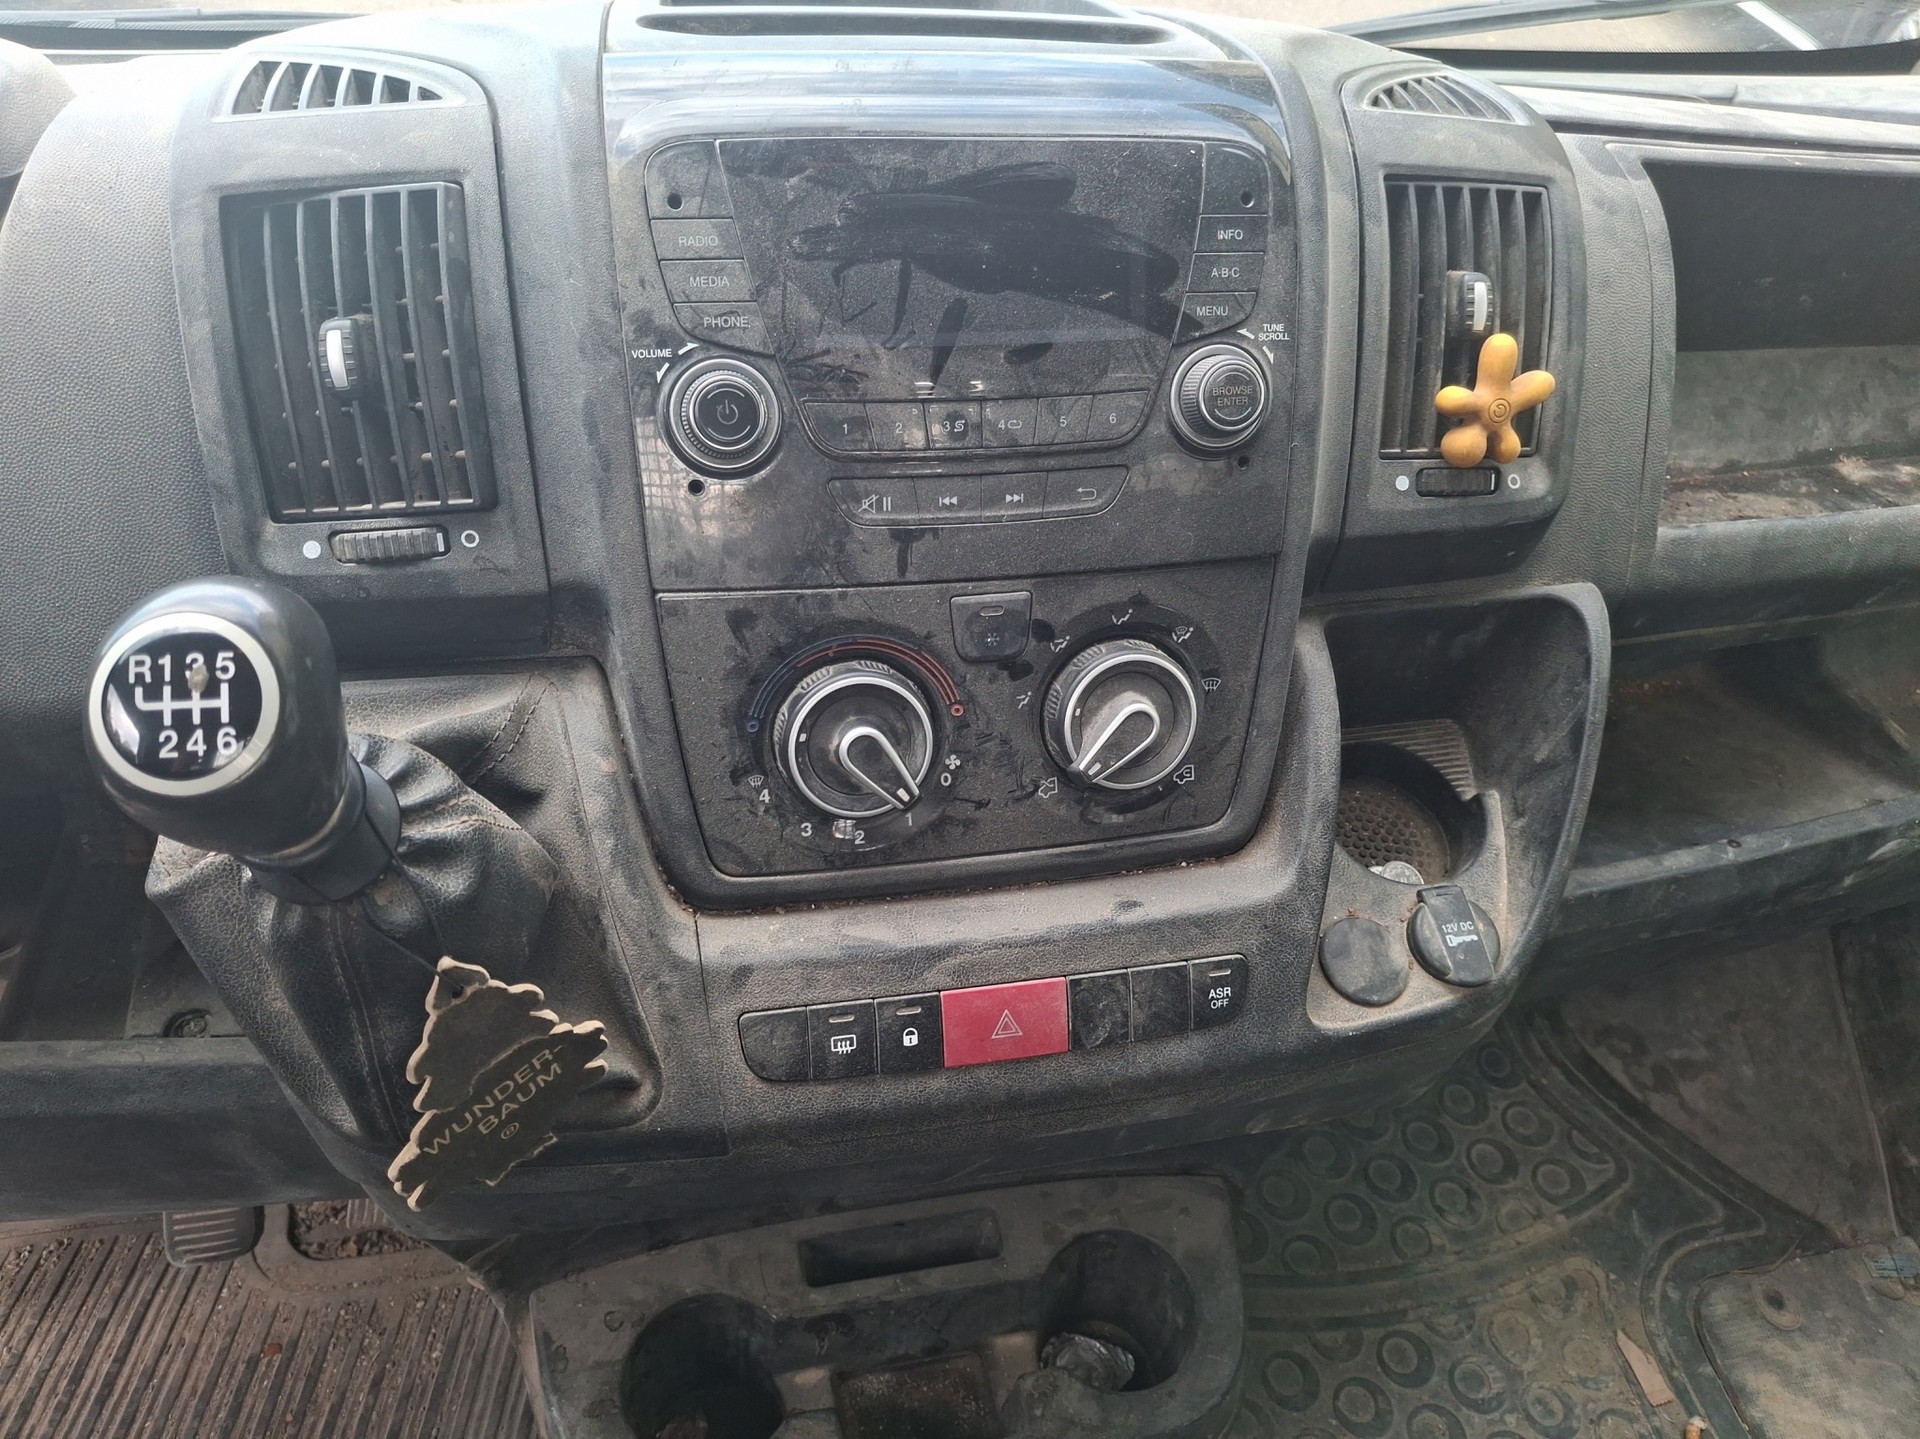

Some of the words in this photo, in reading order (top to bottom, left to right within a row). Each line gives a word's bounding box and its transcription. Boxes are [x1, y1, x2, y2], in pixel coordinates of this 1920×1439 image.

[1217, 229, 1244, 240] INFO
[678, 235, 719, 247] RADIO
[689, 275, 730, 287] MEDIA
[1196, 305, 1229, 316] MENU
[703, 316, 749, 328] PHONE
[1262, 323, 1285, 332] TUNE
[1258, 332, 1291, 341] SCROLL
[631, 348, 673, 359] VOLUME
[1212, 385, 1254, 397] BROWSE
[1217, 396, 1249, 407] ENTER
[842, 423, 848, 435] 1
[895, 423, 903, 434] 2
[942, 421, 951, 433] 3
[997, 419, 1006, 430] 4
[1059, 416, 1067, 427] 5
[1109, 413, 1117, 424] 6
[128, 654, 152, 684] R
[157, 654, 172, 682] 1
[215, 652, 236, 680] 5
[158, 730, 179, 759] 2
[185, 728, 207, 757] 4
[216, 727, 237, 755] 6
[759, 789, 771, 803] 4
[905, 813, 913, 827] 1
[800, 822, 813, 837] 3
[854, 830, 866, 845] 2
[1441, 922, 1458, 934] 12V
[1459, 921, 1474, 931] DC
[1208, 987, 1232, 999] ASR
[1210, 998, 1229, 1009] OFF
[423, 1045, 563, 1155] WUNDER-
[477, 1062, 563, 1135] BAUM
